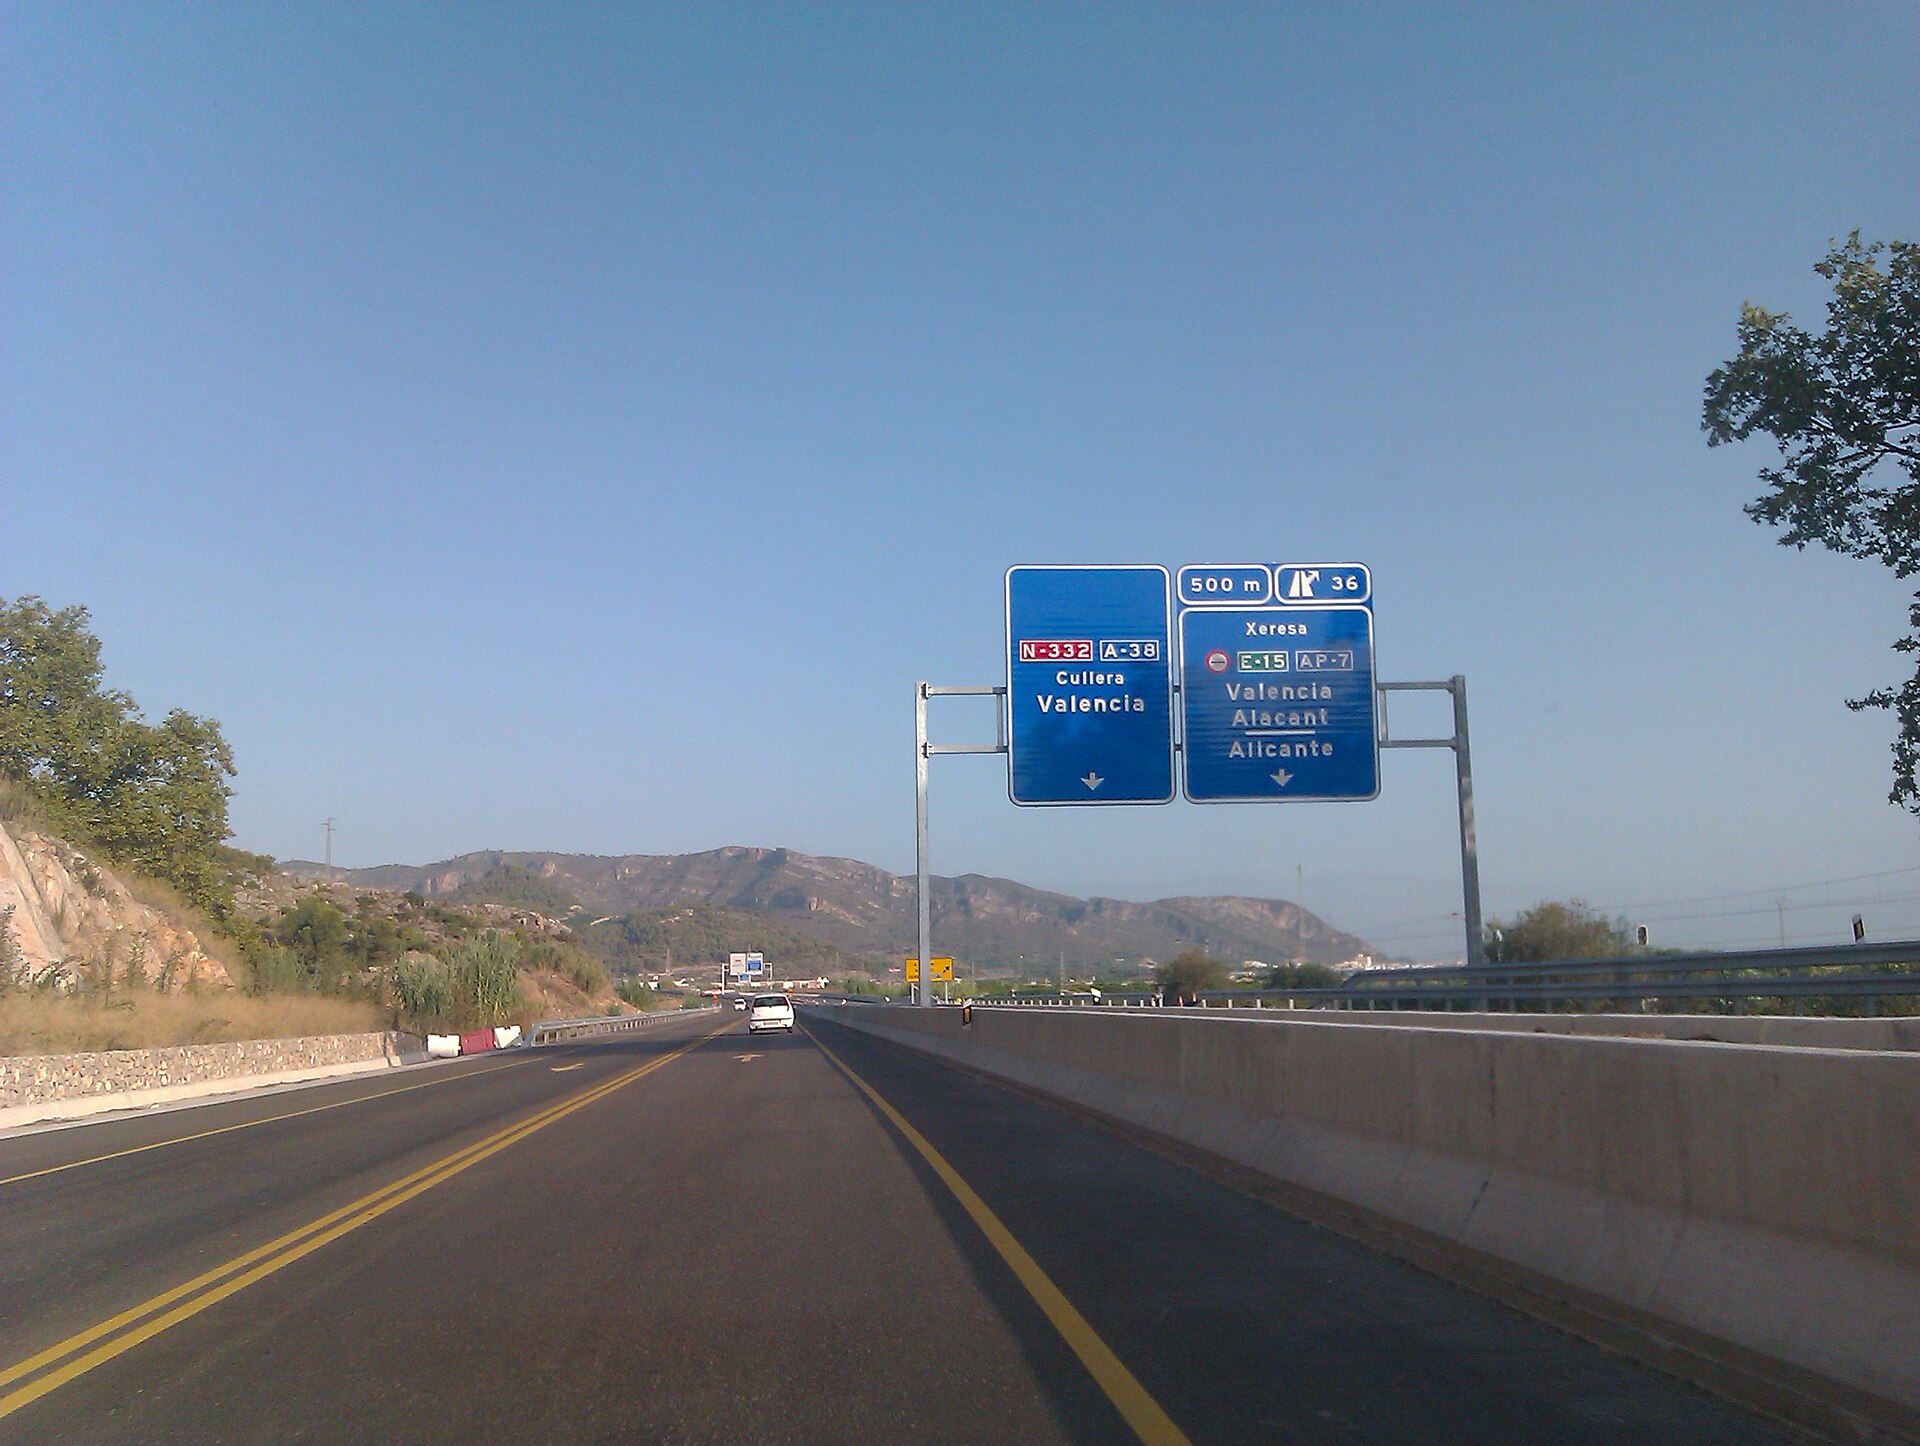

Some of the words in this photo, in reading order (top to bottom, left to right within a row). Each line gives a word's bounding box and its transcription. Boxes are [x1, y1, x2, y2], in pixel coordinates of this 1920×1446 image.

[1190, 577, 1233, 593] 500
[1243, 579, 1260, 593] m
[1331, 576, 1359, 591] 36
[1245, 622, 1307, 636] Xeresa
[1022, 643, 1090, 658] N-332
[1103, 643, 1156, 658] A-38
[1240, 655, 1286, 669] E-15
[1299, 654, 1350, 668] AP-7
[1055, 671, 1124, 685] Cullera
[1225, 683, 1333, 701] Valencia
[1037, 695, 1145, 713] Valencia
[1231, 709, 1328, 727] Alacant
[1228, 740, 1334, 758] Alicante
